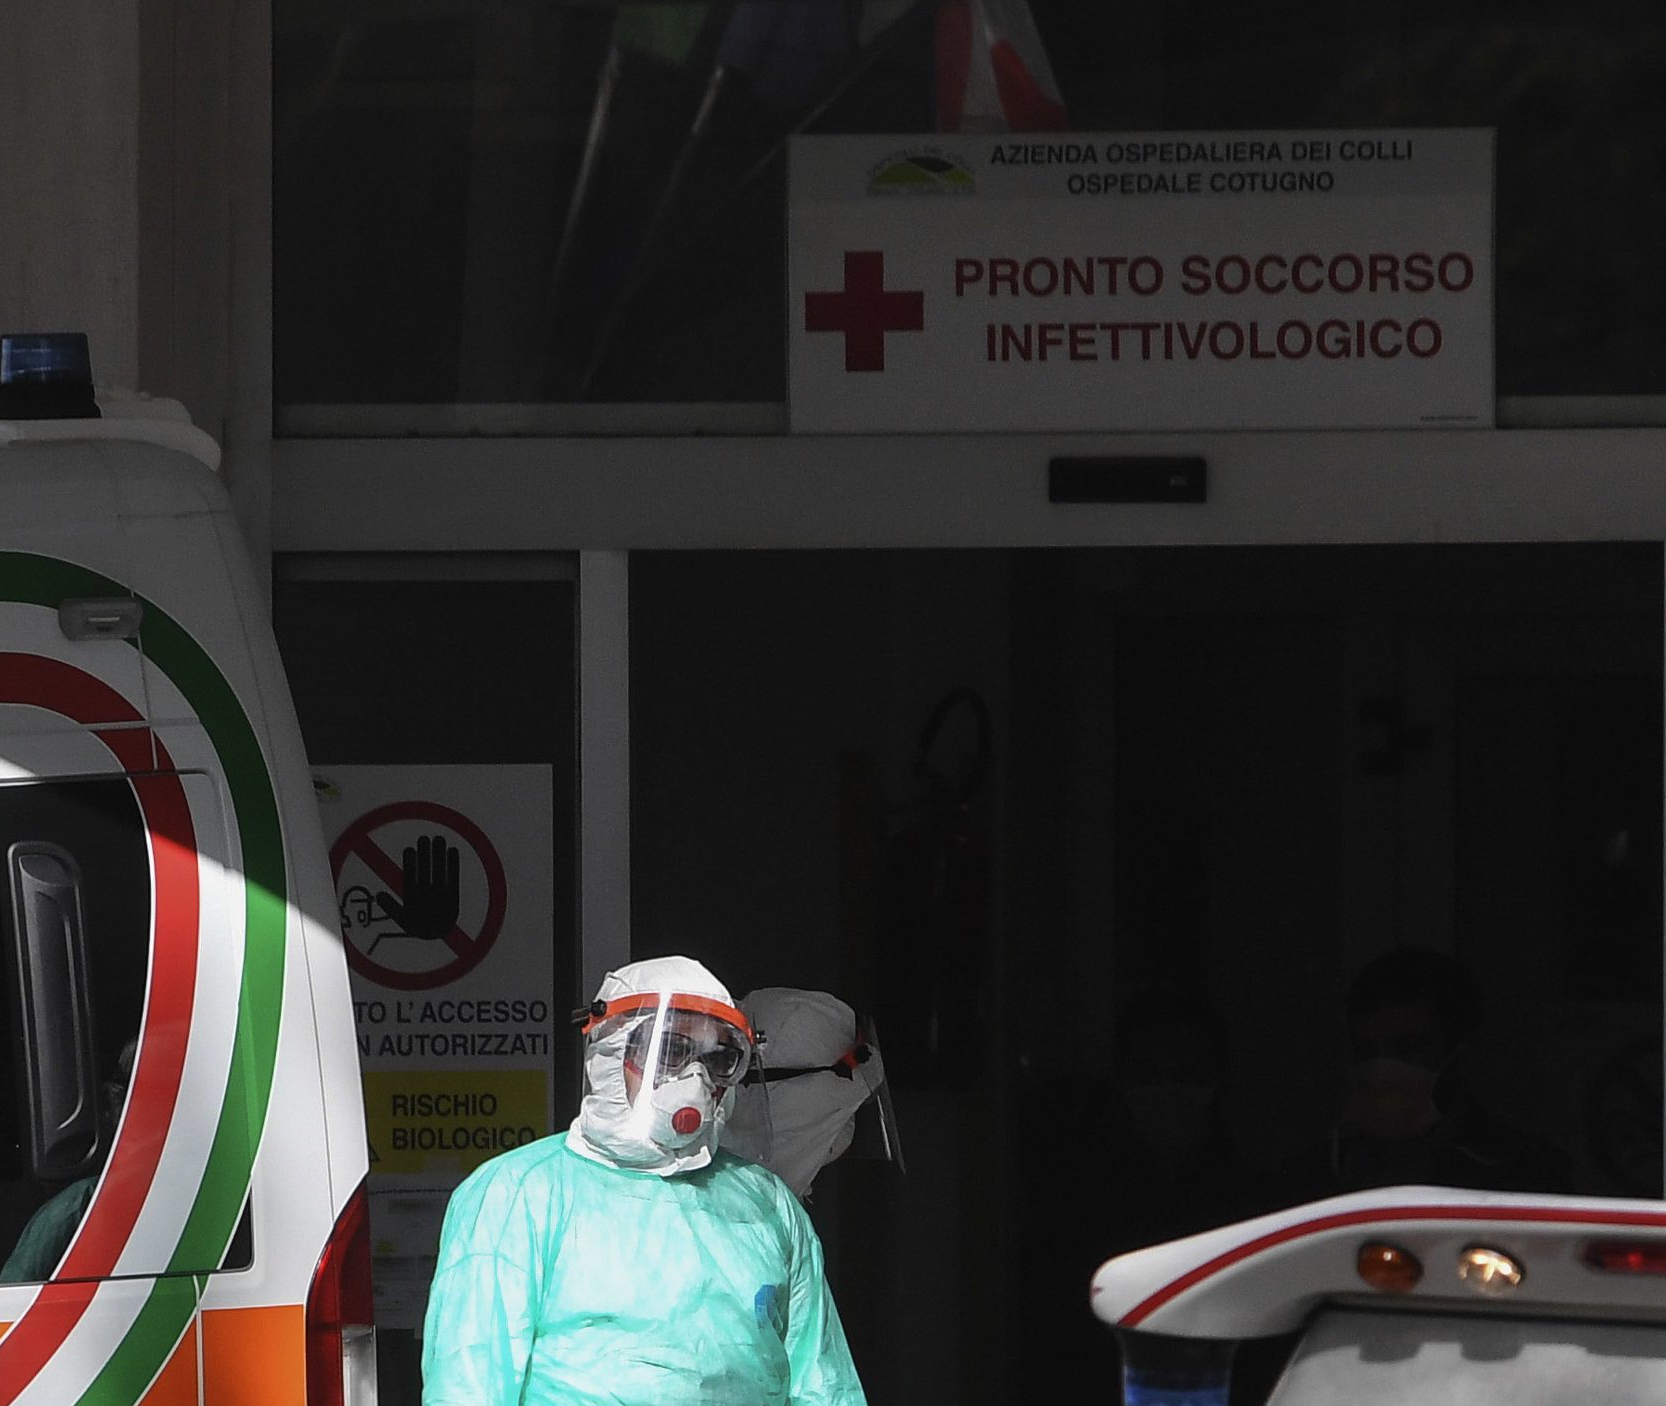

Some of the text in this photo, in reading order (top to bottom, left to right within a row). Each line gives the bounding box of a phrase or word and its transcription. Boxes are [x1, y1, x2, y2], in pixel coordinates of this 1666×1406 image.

[990, 142, 1097, 166] AZIENDA
[1105, 141, 1282, 164] OSPEDALIERA
[1290, 140, 1332, 161] DEI
[1338, 139, 1413, 161] COLLI
[1067, 169, 1333, 195] OSPEDALE COTUGNO
[954, 250, 1476, 298] PRONTO SOCCORSO
[986, 317, 1444, 362] INFETTIVOLOGICO
[378, 1033, 549, 1058] AUTORIZZATI
[392, 1093, 498, 1118] RISCHIO
[392, 1126, 538, 1152] BIOLOGICO
